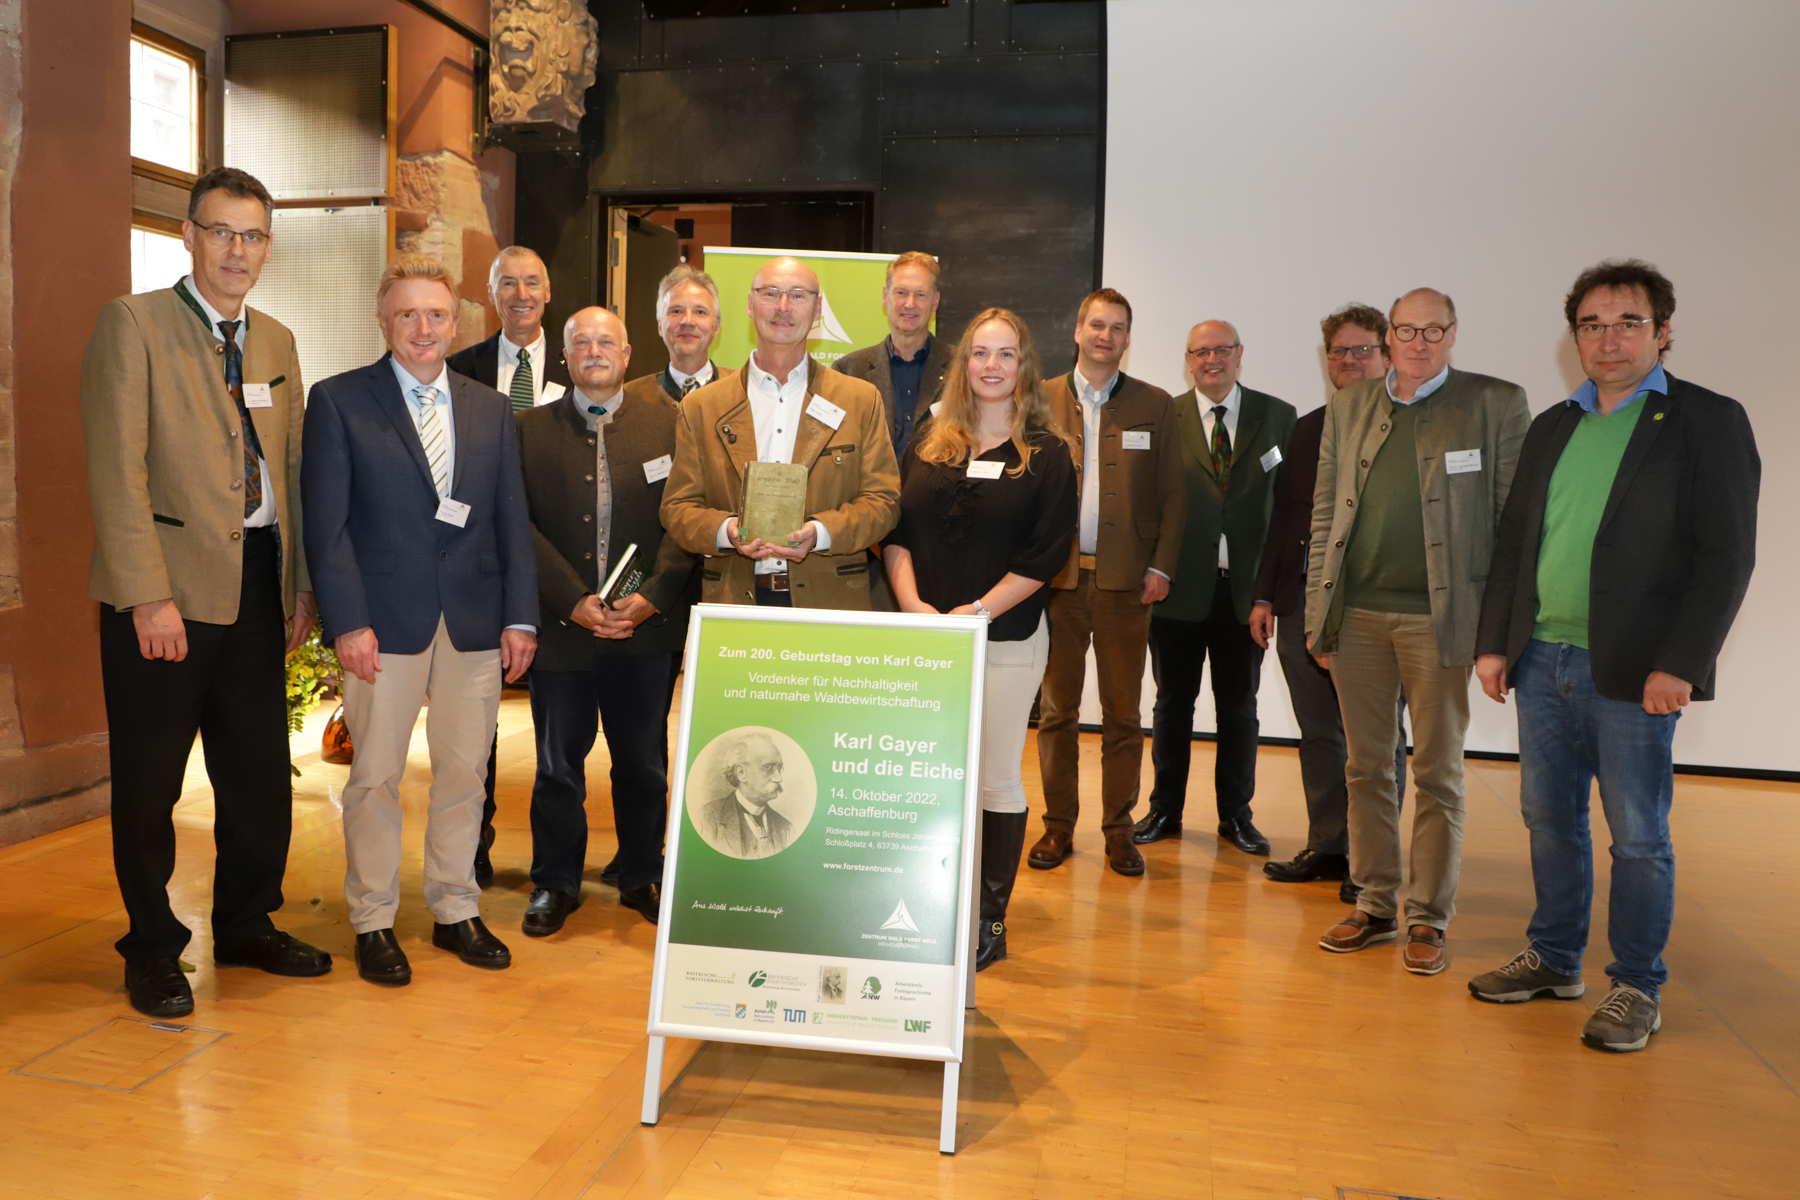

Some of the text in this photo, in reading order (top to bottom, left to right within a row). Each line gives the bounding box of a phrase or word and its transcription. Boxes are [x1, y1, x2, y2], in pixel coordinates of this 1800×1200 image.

[718, 646, 954, 670] Zum 200. Geburtstag von Karl Gayer
[748, 672, 919, 693] Vordenker für Nachhaltigkeit
[724, 688, 941, 712] und naturnahe Waldbewirtschaftung
[834, 732, 937, 756] Karl Gayer
[832, 758, 964, 780] und die Eiche
[830, 788, 940, 806] 14. Oktober 2022,
[827, 804, 918, 823] Aschaffenburg
[826, 827, 870, 837] Ridingersaal
[882, 830, 910, 839] Schloss
[825, 839, 866, 848] Schloßplatz
[823, 862, 903, 873] www.forstzentrum.de
[783, 1008, 806, 1023] TUM
[904, 1019, 931, 1033] LWF
